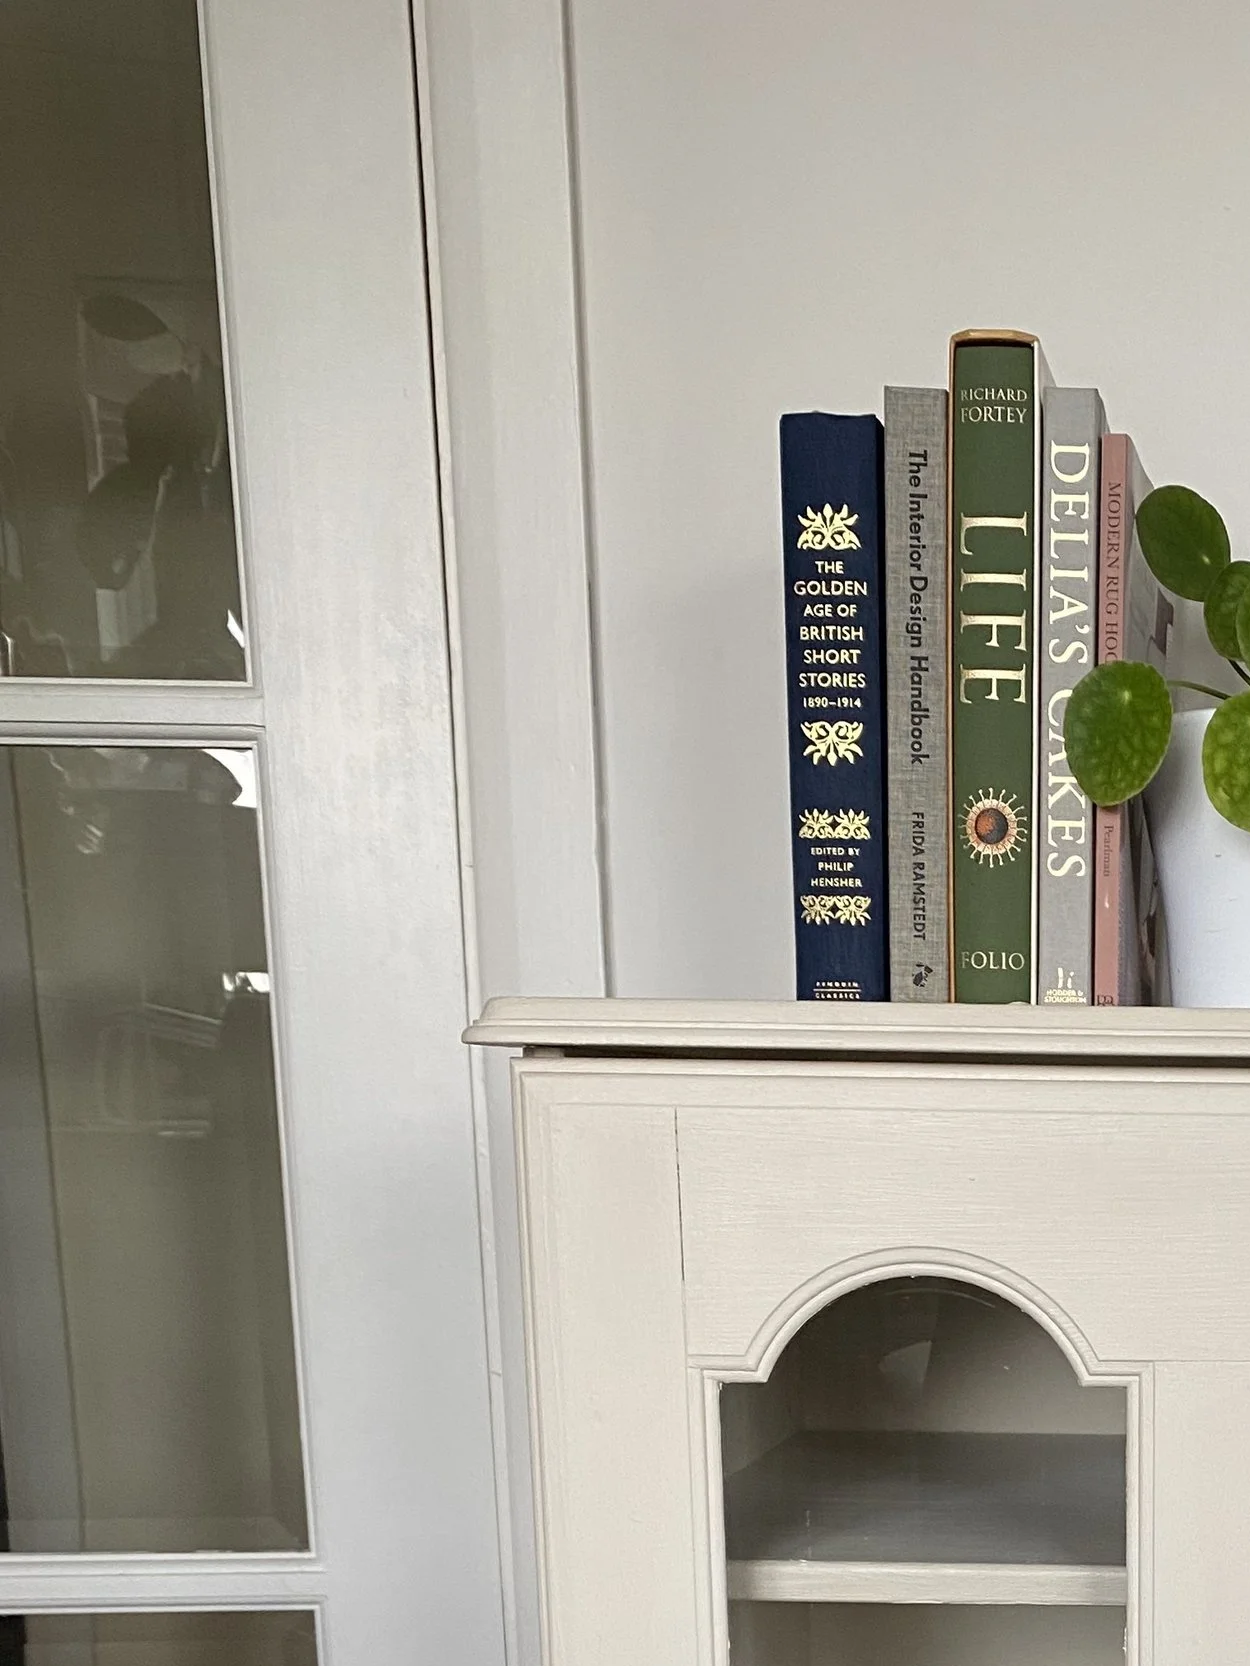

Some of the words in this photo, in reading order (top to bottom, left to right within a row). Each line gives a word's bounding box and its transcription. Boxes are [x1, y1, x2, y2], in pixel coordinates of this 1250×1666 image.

[960, 388, 1027, 402] RICHARD
[960, 406, 1027, 424] FORTEY
[908, 450, 928, 486] The
[908, 491, 928, 570] Interior
[1107, 482, 1122, 569] MODERN
[1049, 440, 1090, 664] DELIA'S
[815, 561, 844, 574] THE
[794, 581, 868, 596] GOLDEN
[1105, 576, 1119, 615] RUG
[803, 604, 832, 617] AGE
[837, 604, 857, 617] OF
[906, 576, 929, 648] Design
[959, 512, 1027, 704] LIFE
[800, 626, 864, 641] BRITISH
[803, 649, 861, 664] SHORT
[799, 673, 866, 688] STORIES
[911, 656, 931, 765] Handbook
[912, 812, 925, 857] FRIDA
[810, 847, 845, 856] EDITED
[848, 847, 861, 856] BY
[818, 862, 854, 871] PHILIP
[811, 878, 863, 888] HENSHER
[912, 862, 926, 940] RAMSTEDT
[961, 951, 1025, 970] FOLIO
